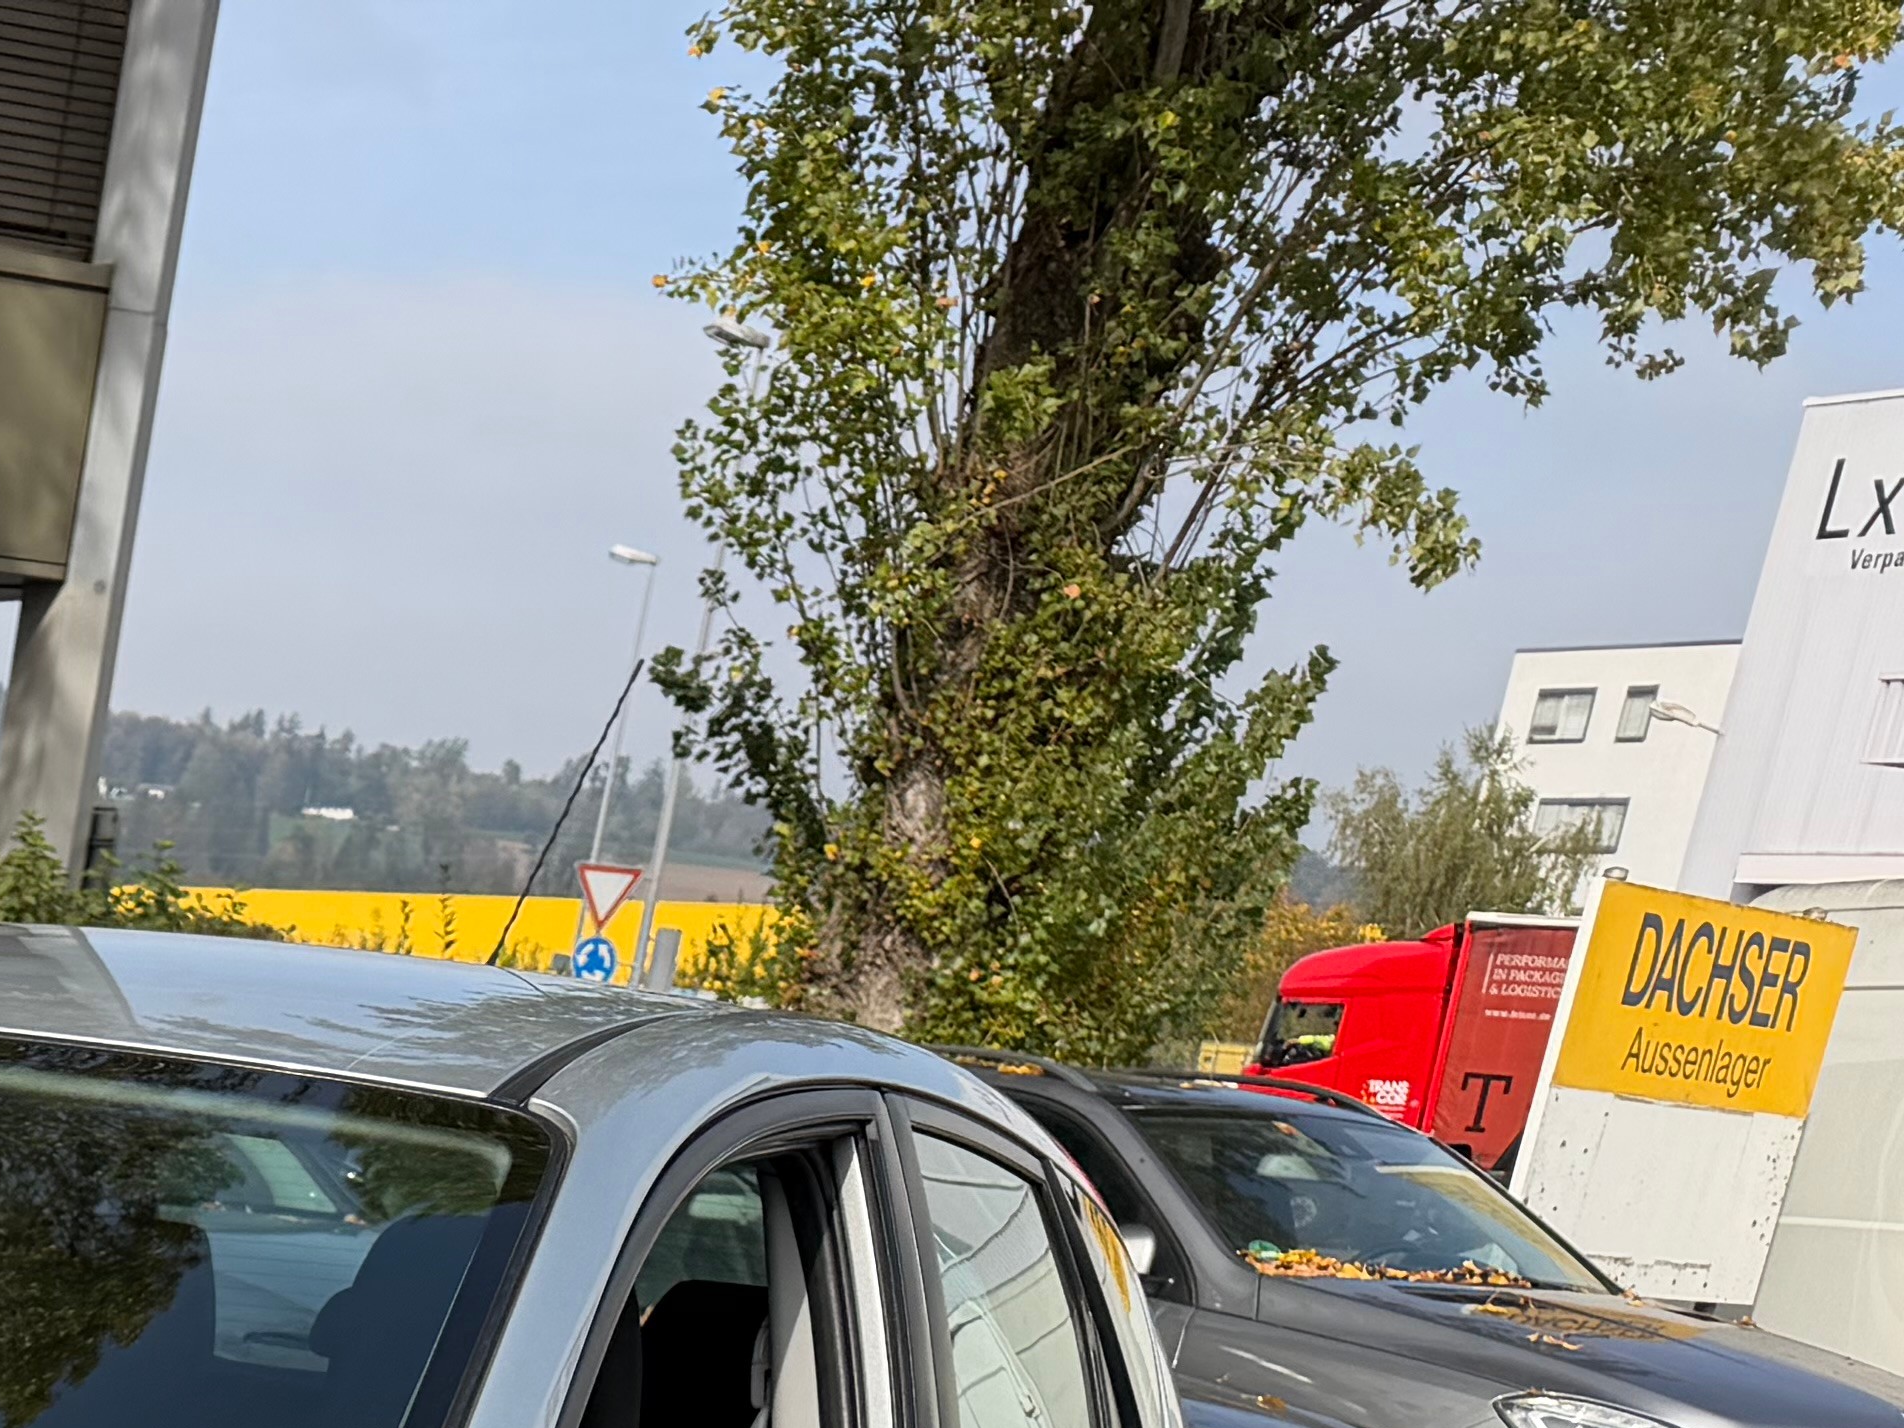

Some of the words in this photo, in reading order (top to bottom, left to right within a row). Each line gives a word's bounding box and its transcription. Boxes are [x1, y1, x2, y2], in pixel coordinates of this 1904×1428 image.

[1493, 968, 1508, 980] IN
[1621, 911, 1811, 1032] DACHSER
[1621, 1026, 1771, 1098] Aussenlager
[1461, 1072, 1513, 1133] T
